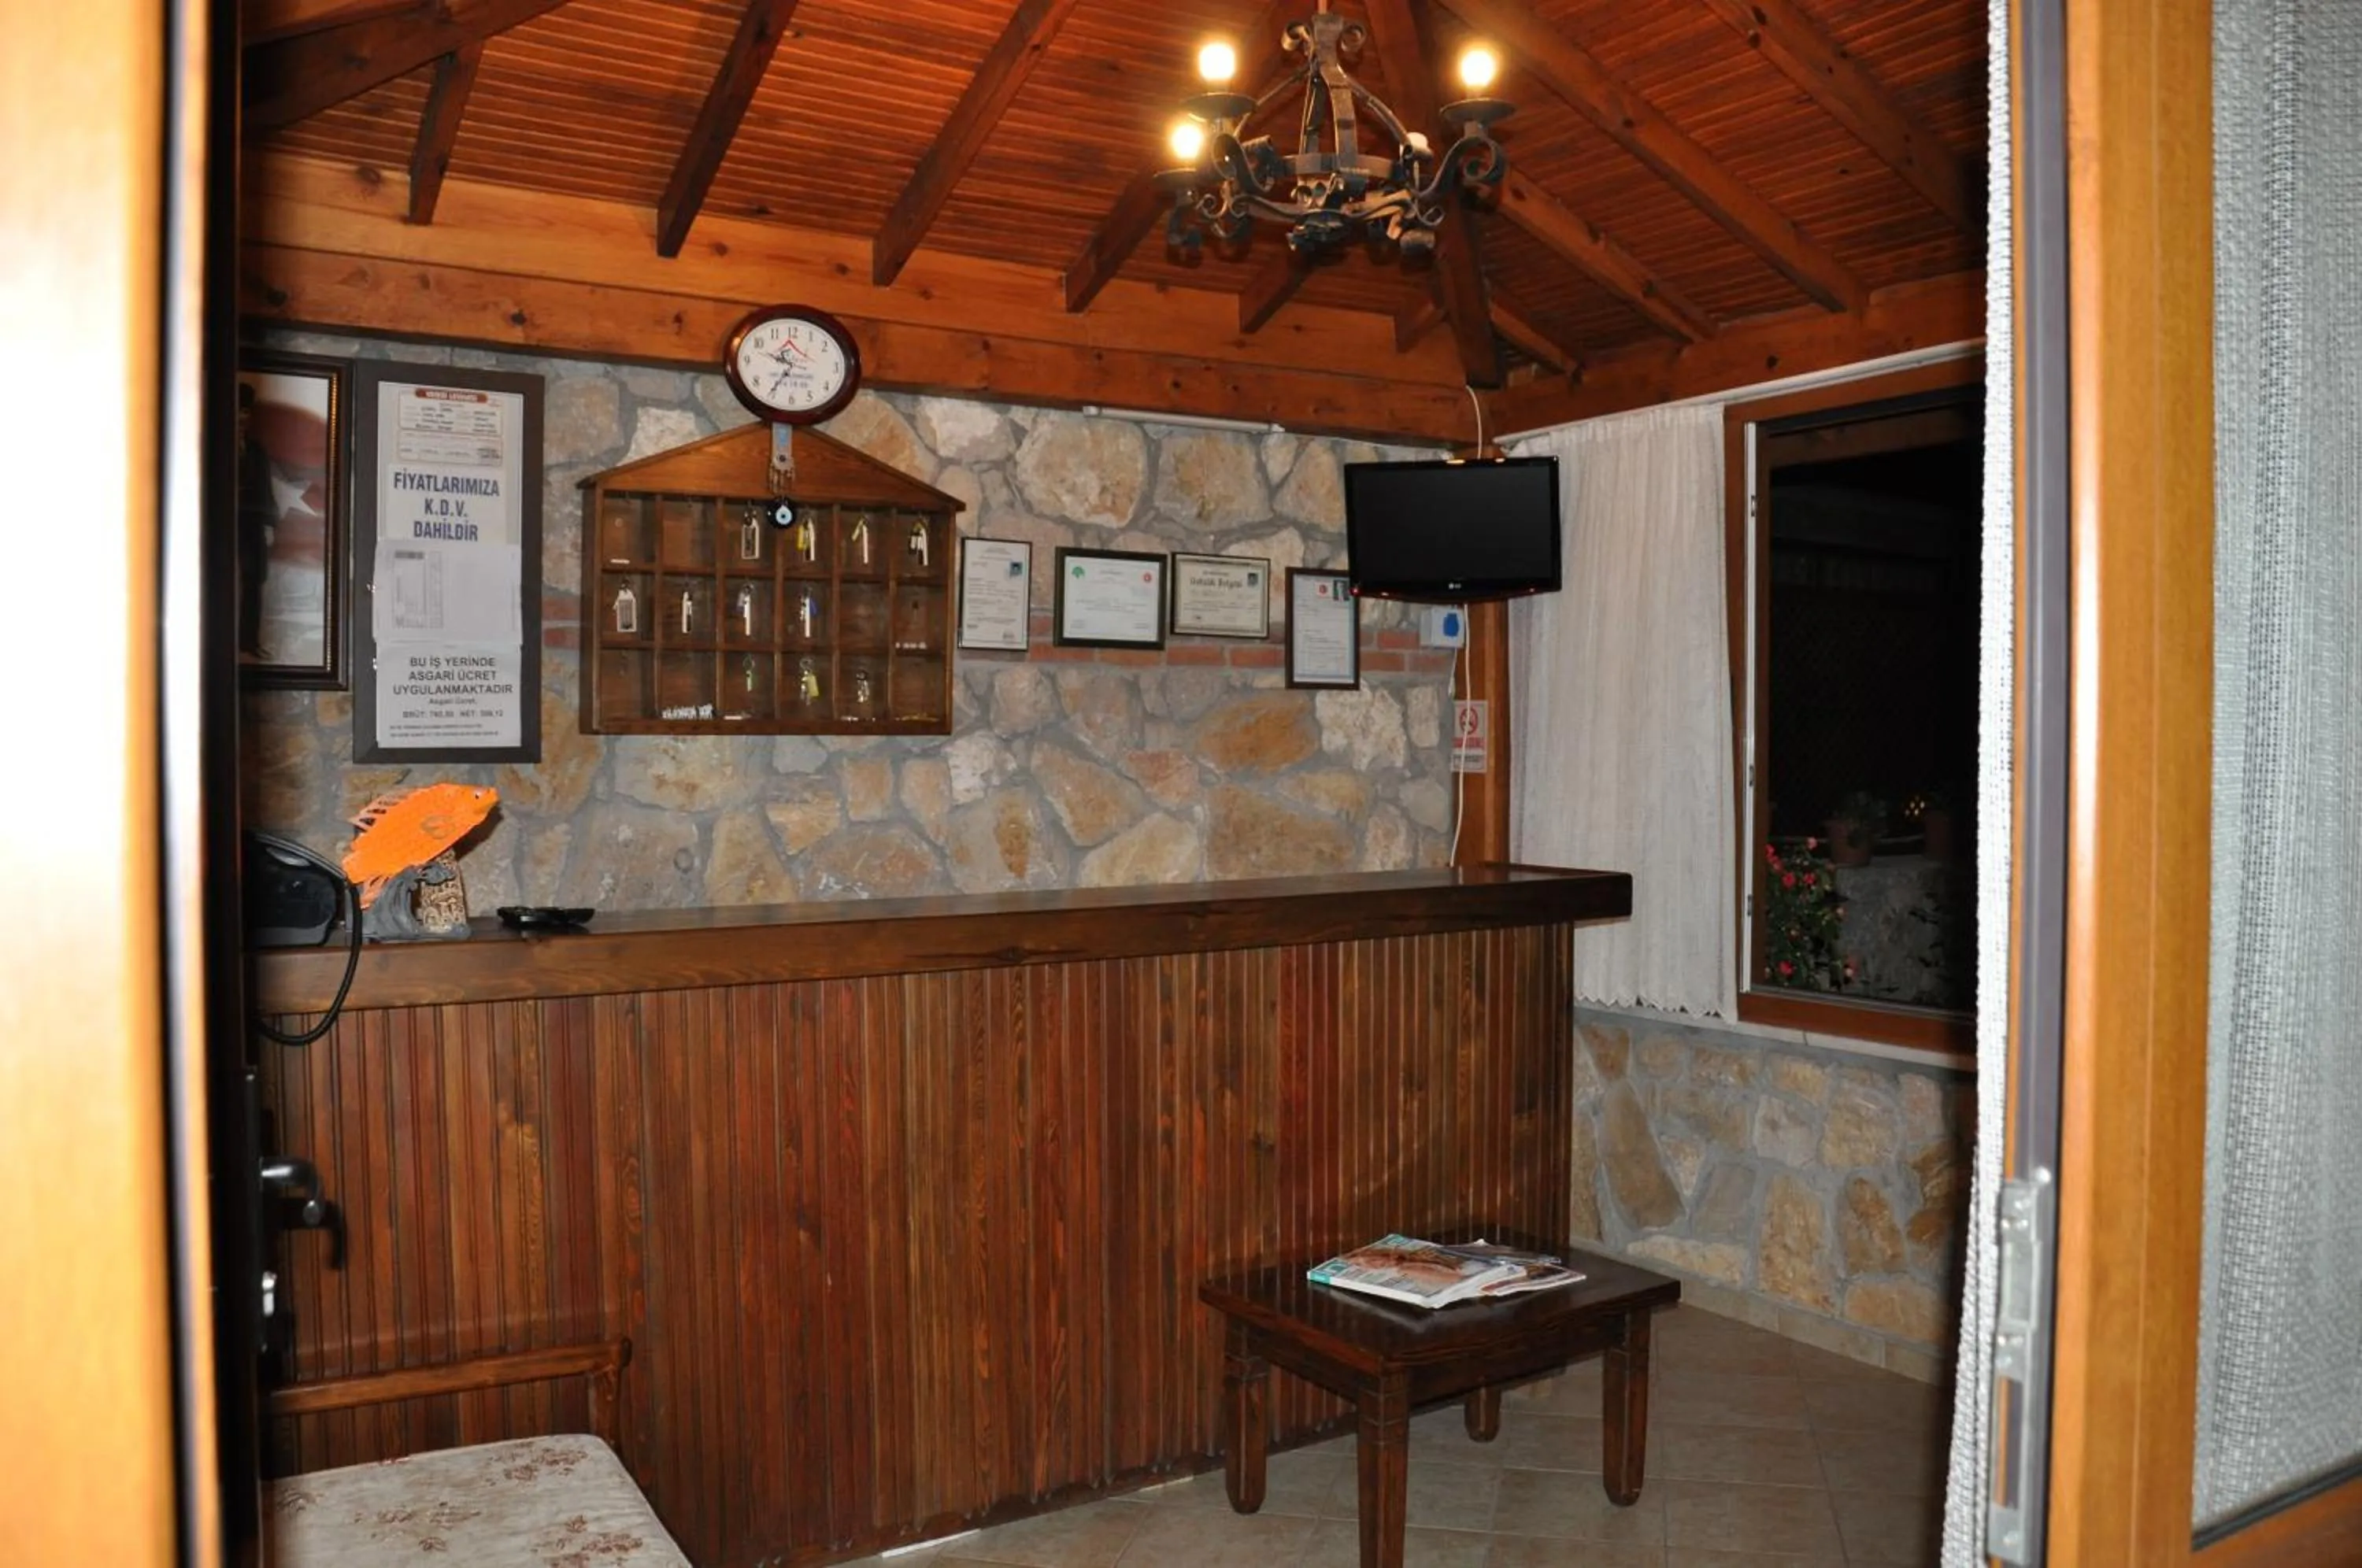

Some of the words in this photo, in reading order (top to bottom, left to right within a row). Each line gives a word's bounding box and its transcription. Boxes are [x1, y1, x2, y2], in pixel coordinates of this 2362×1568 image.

[771, 328, 779, 339] 11
[788, 327, 798, 338] 12
[754, 337, 764, 349] 10
[821, 340, 828, 353] 2
[394, 468, 500, 497] FİYATLARIMIZA
[424, 498, 468, 517] K.D.V.
[413, 519, 478, 542] DAHİLDİR
[410, 656, 426, 667] BU
[430, 656, 441, 668] İŞ
[445, 655, 496, 667] YERİNDE
[409, 669, 455, 681] ASGARİ
[458, 669, 497, 681] ÜCRET
[393, 683, 513, 695] UYGULANMAKTADIR
